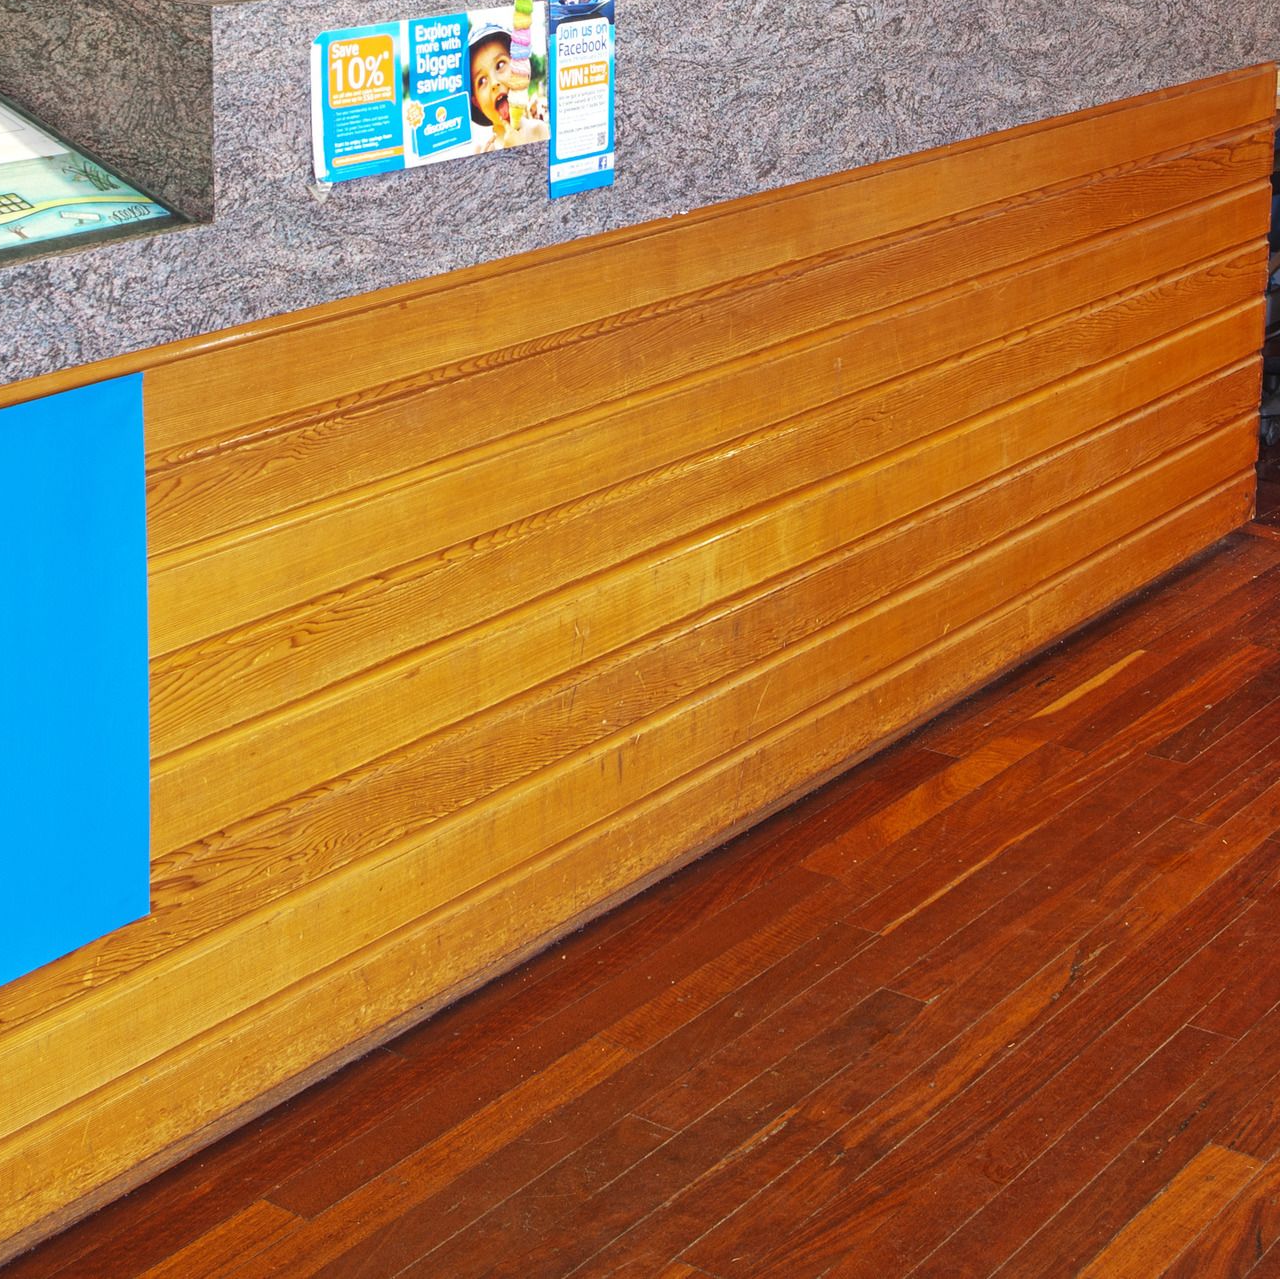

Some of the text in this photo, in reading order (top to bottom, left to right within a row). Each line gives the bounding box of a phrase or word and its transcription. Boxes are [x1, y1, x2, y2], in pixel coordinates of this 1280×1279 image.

[415, 23, 460, 43] Explore
[558, 23, 607, 41] Join us on
[332, 44, 359, 59] Save
[416, 38, 461, 54] more with
[558, 35, 607, 57] Facebook
[417, 52, 462, 77] bigger
[417, 75, 462, 94] savings
[559, 67, 583, 89] WIN
[424, 116, 463, 136] discovery
